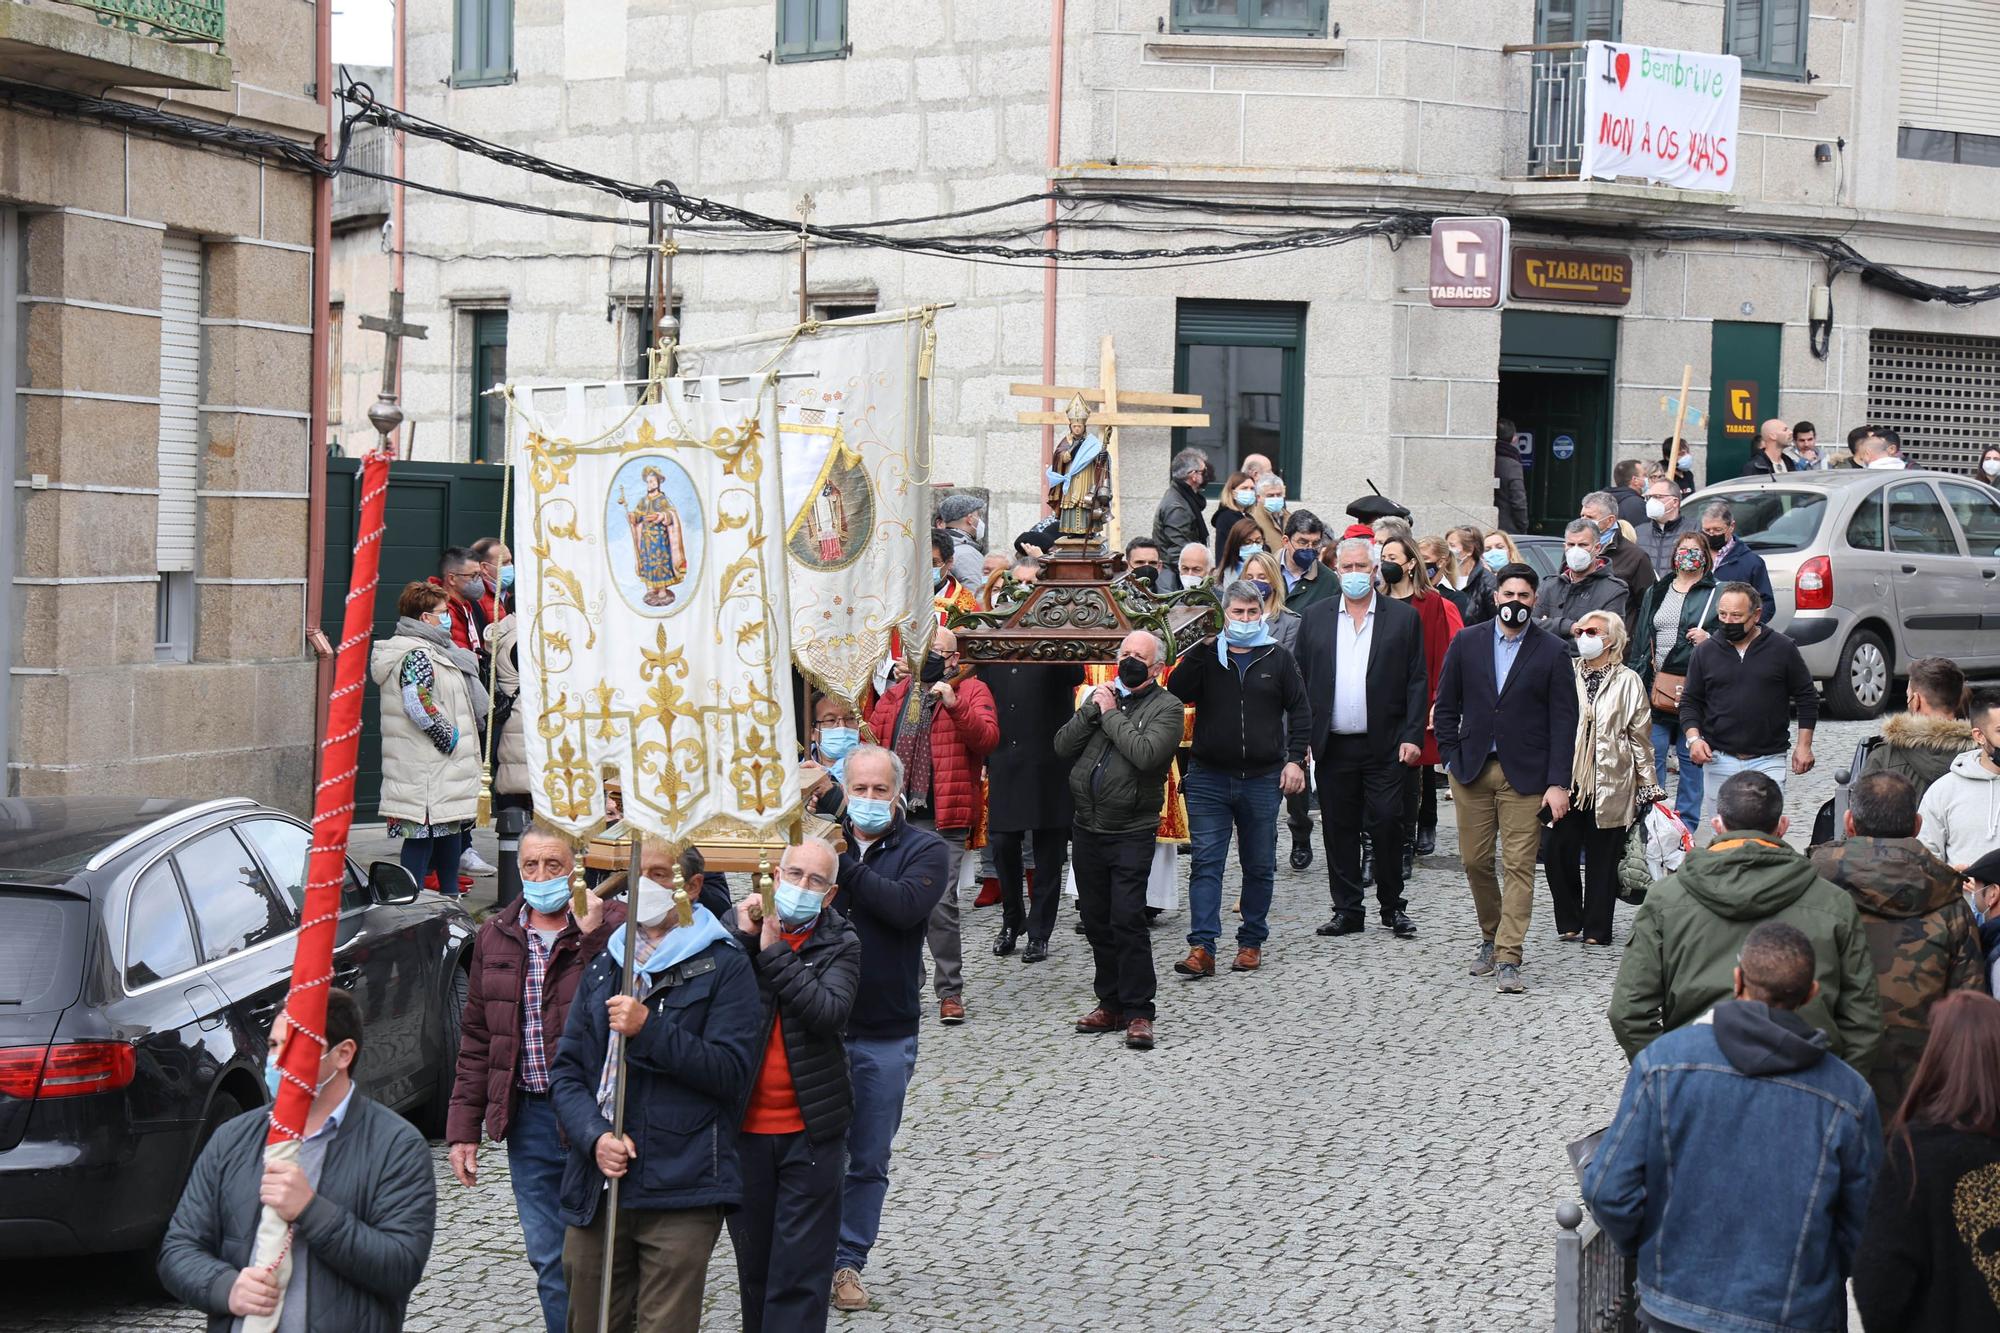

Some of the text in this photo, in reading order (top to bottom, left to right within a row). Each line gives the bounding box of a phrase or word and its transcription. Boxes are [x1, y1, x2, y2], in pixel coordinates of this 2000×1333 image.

[1602, 44, 1723, 98] I Bembrive
[1599, 112, 1635, 156] NON
[1641, 121, 1651, 153] A
[1657, 125, 1680, 160] OS
[1546, 260, 1625, 283] TABACOS
[1430, 285, 1492, 300] TABACOS
[1726, 424, 1756, 433] TABACOS
